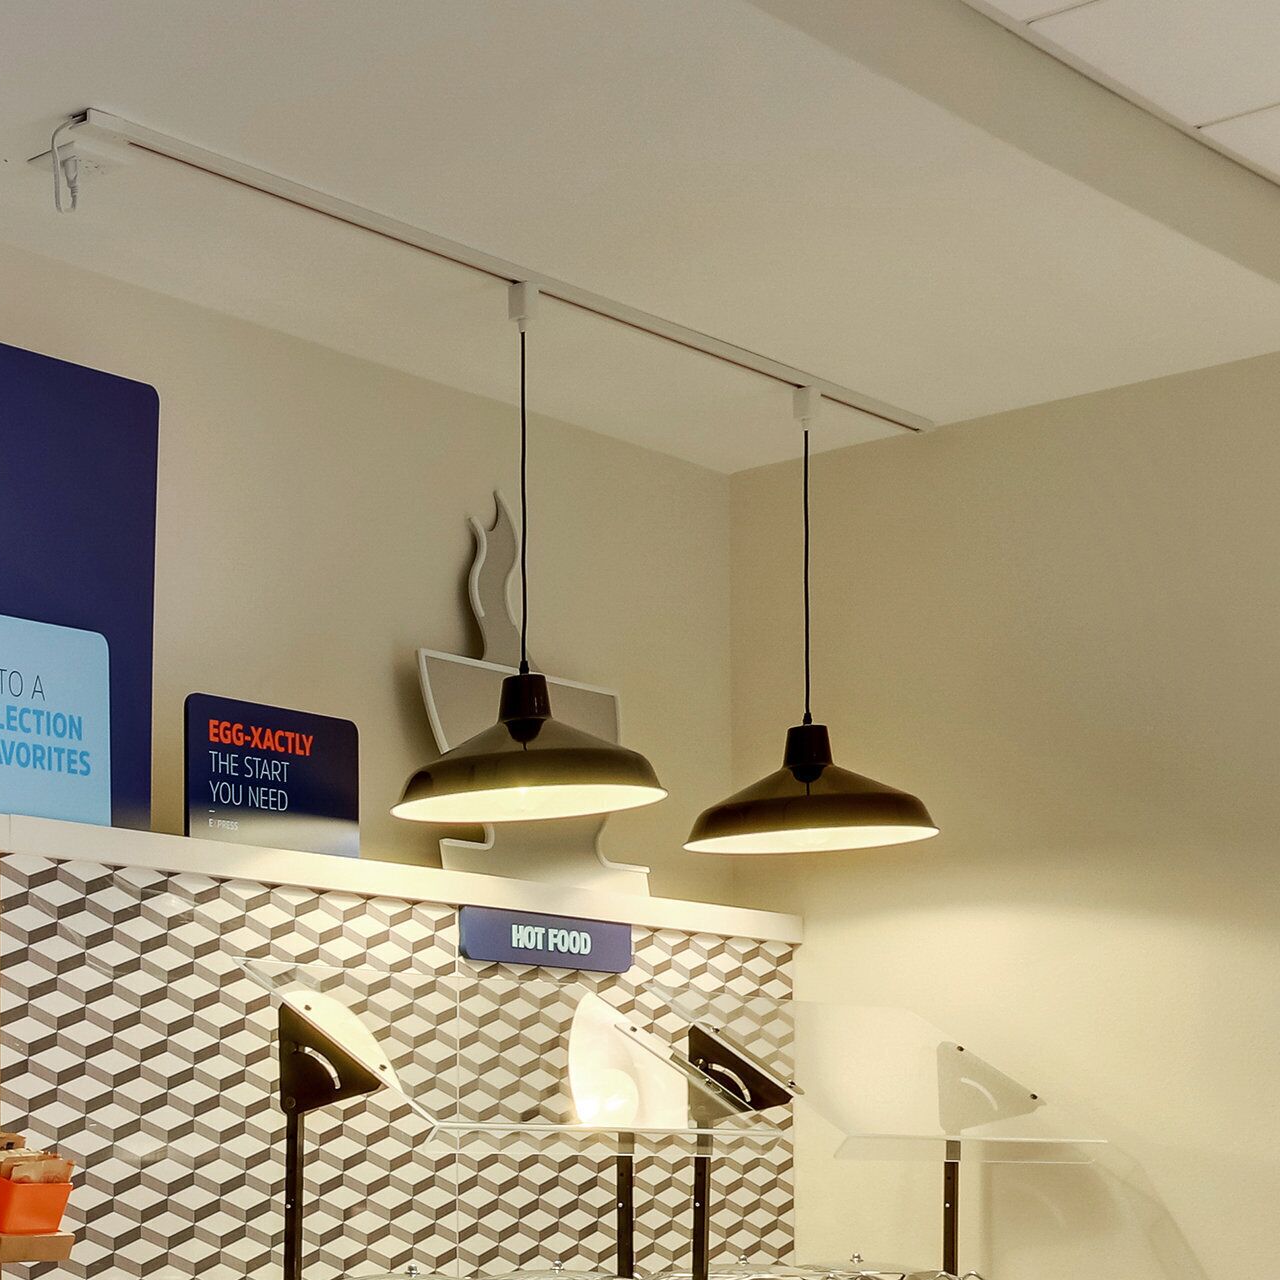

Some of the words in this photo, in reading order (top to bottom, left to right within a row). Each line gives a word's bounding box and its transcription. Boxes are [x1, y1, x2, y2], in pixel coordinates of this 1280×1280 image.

[31, 674, 46, 701] A
[208, 719, 314, 756] EGG-XACTLY
[208, 750, 239, 776] THE
[244, 756, 290, 783] START
[209, 780, 242, 806] YOU
[248, 785, 288, 811] NEED
[511, 924, 545, 950] HOT
[548, 928, 592, 955] FOOD
